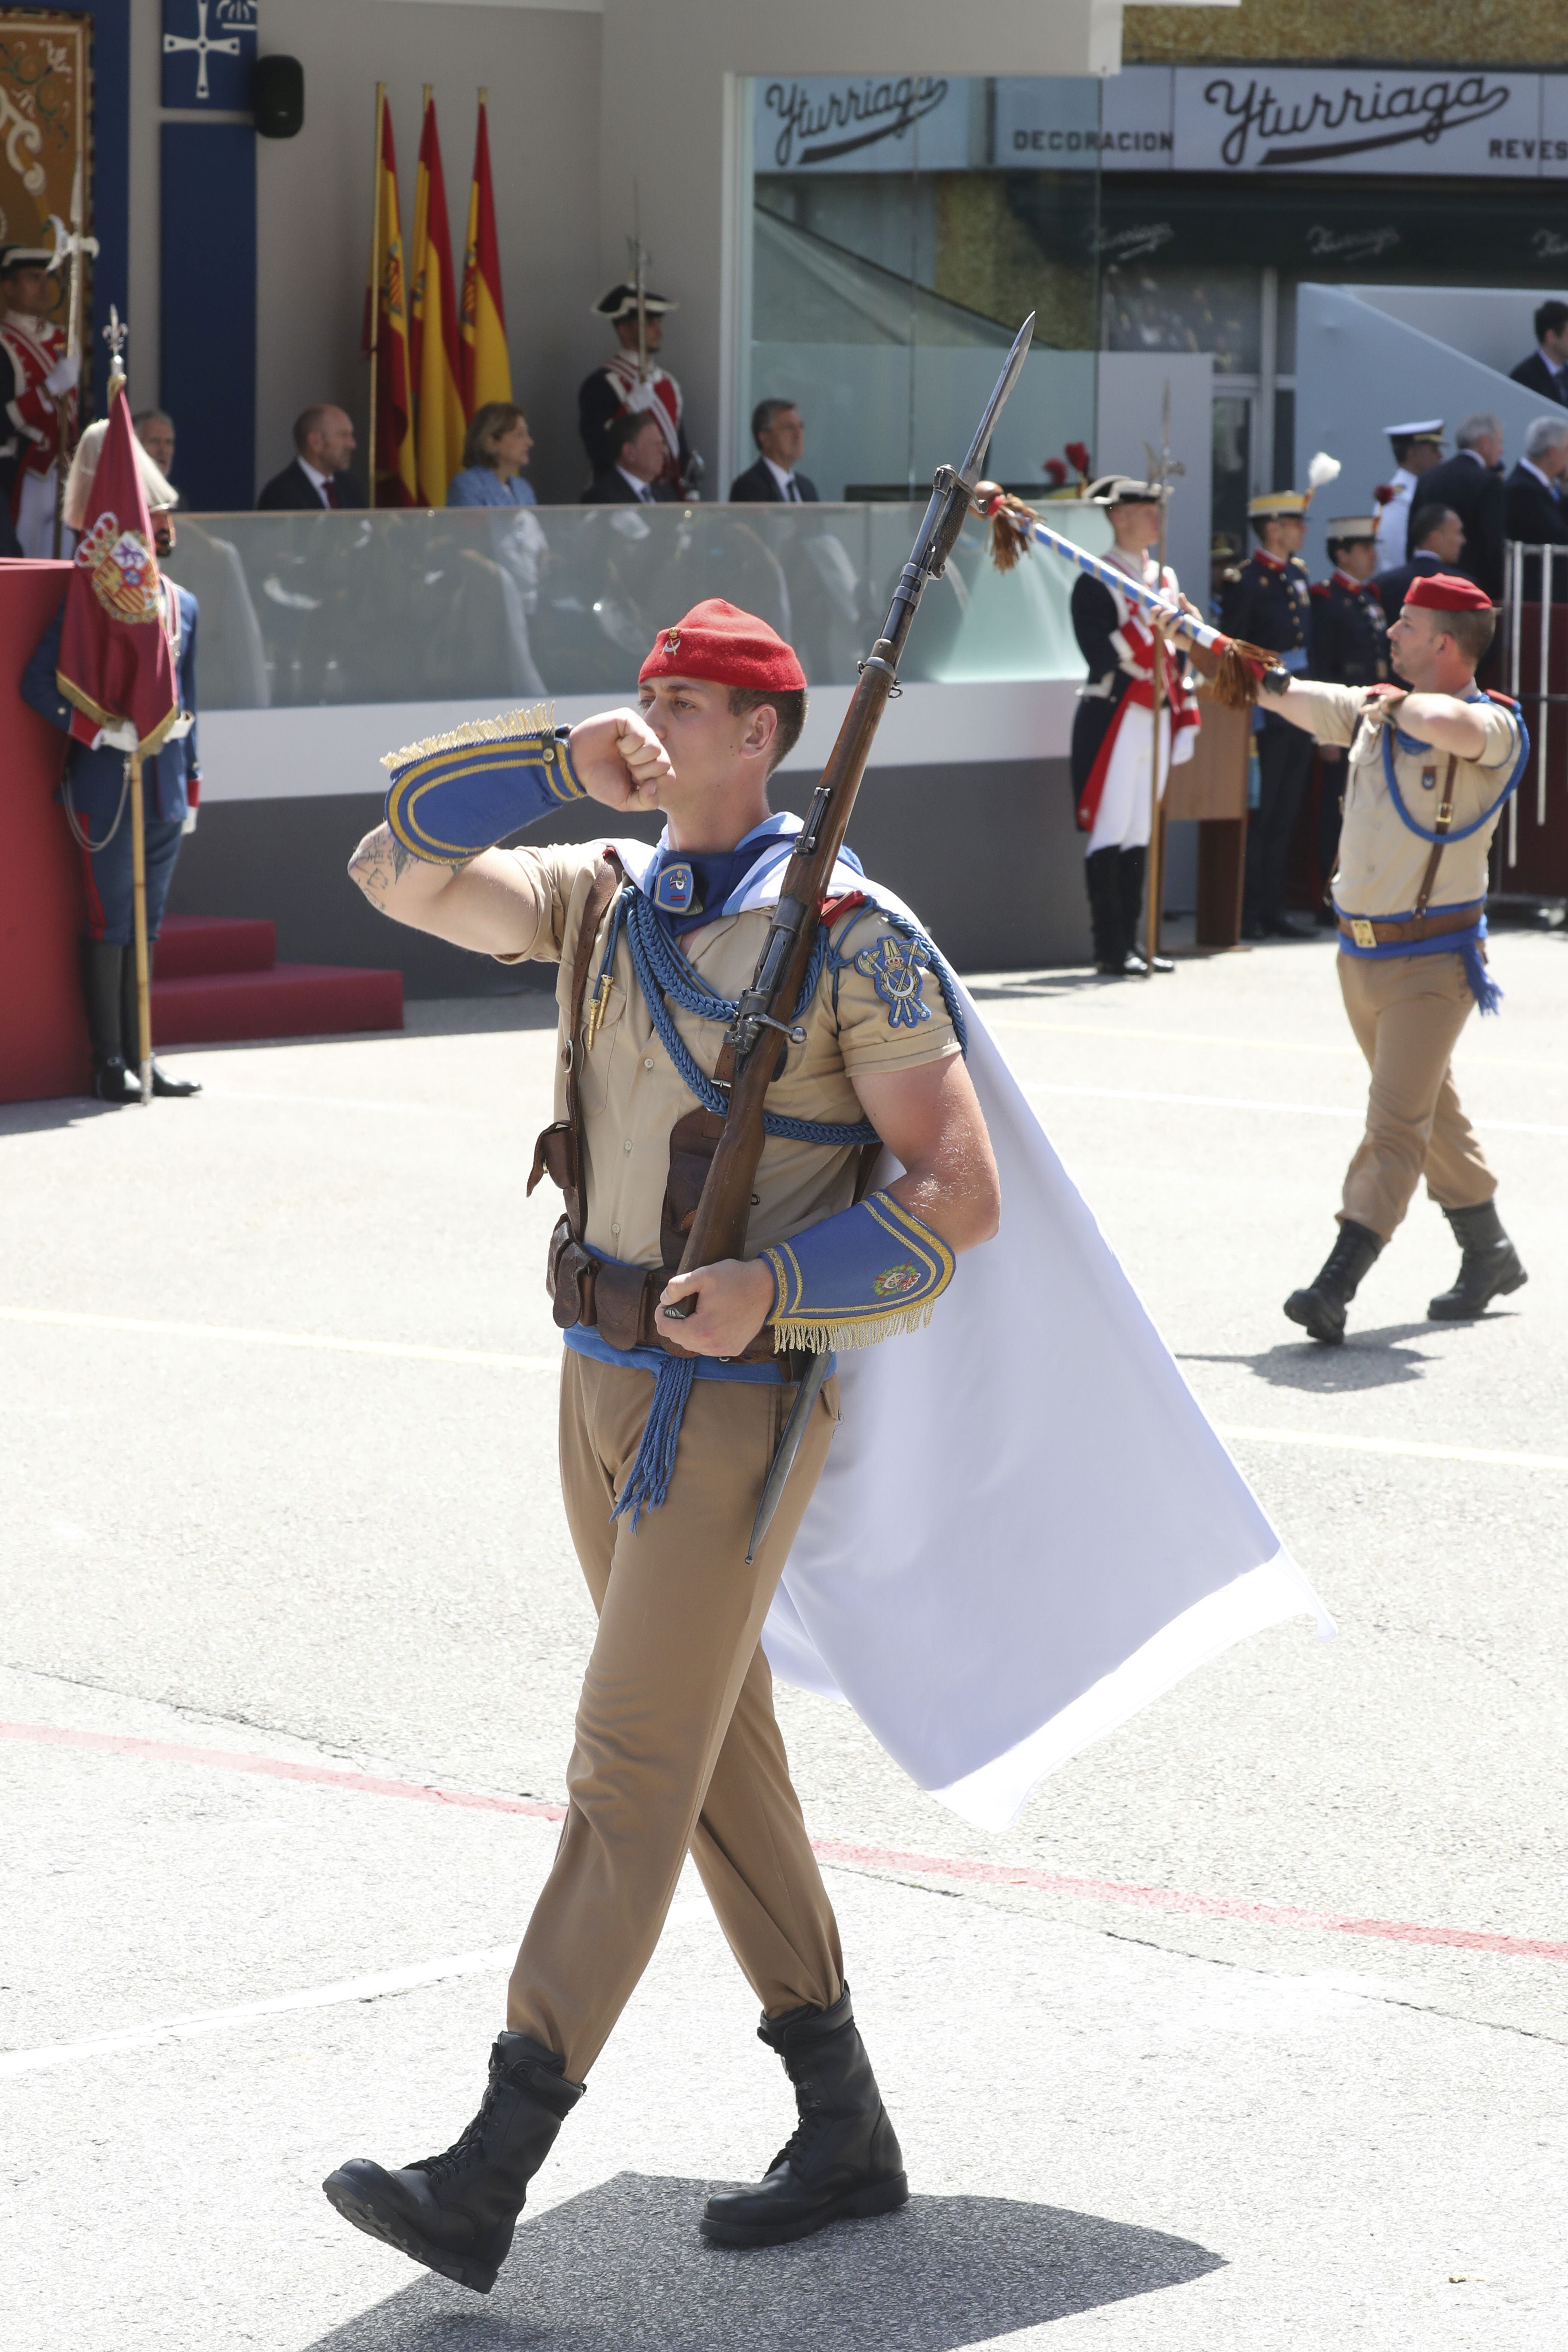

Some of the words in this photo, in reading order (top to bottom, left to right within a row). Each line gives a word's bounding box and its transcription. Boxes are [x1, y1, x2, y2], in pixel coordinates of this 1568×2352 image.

[1204, 76, 1510, 166] Yturriaga
[1014, 130, 1174, 151] DECORACION
[1489, 138, 1568, 160] REVES
